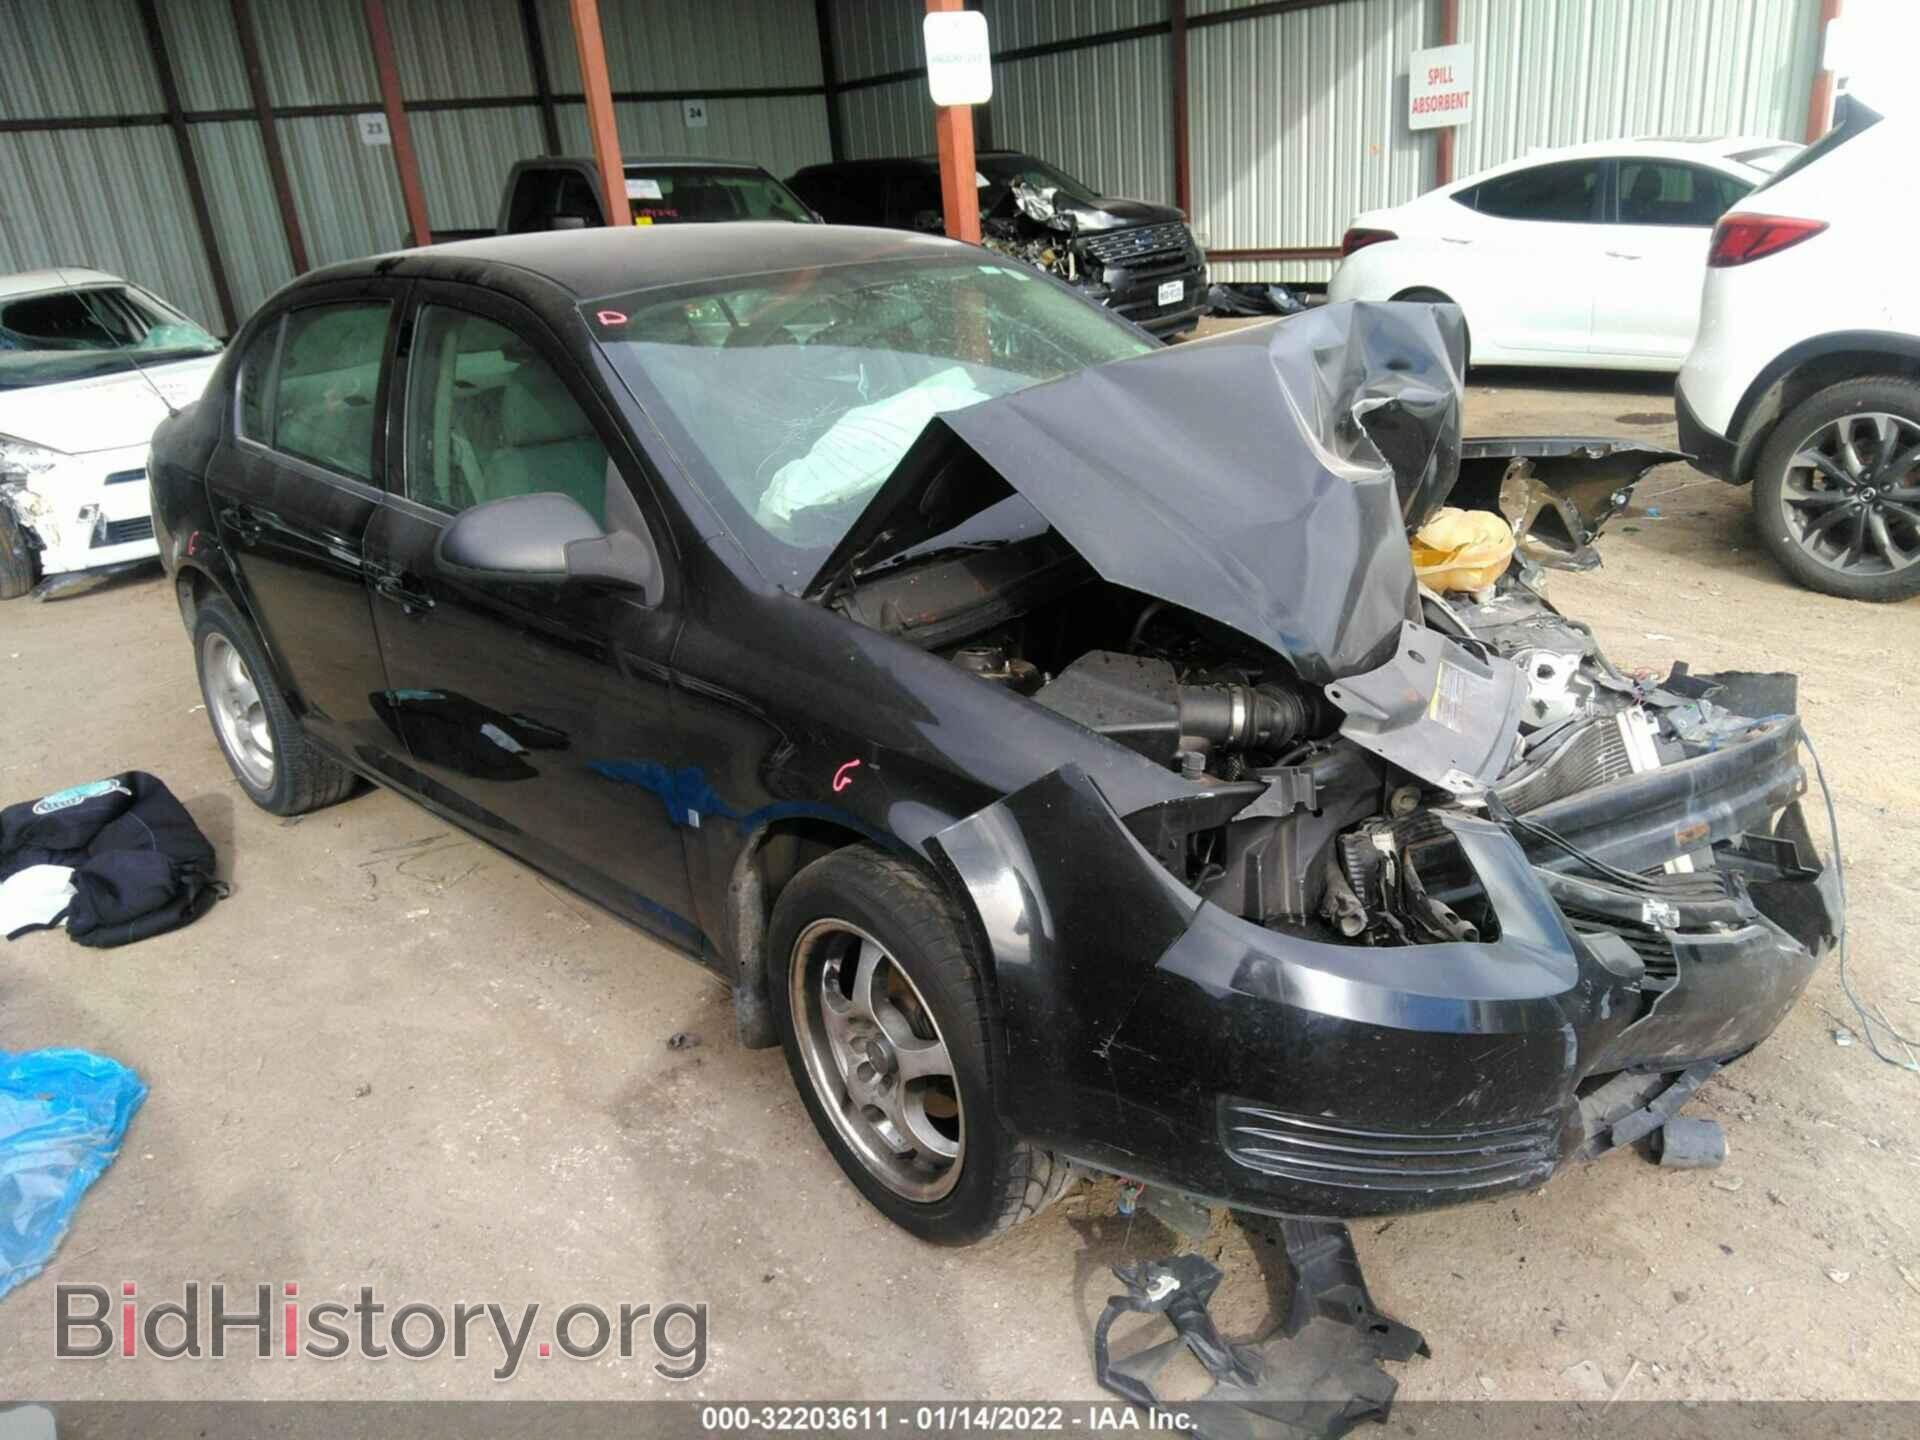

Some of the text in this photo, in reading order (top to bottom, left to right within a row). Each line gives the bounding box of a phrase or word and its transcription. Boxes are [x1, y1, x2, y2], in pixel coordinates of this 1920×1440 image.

[1428, 66, 1453, 85] SPILL
[1412, 91, 1469, 114] ABSORBENT
[690, 107, 702, 118] 24
[367, 122, 383, 134] 23
